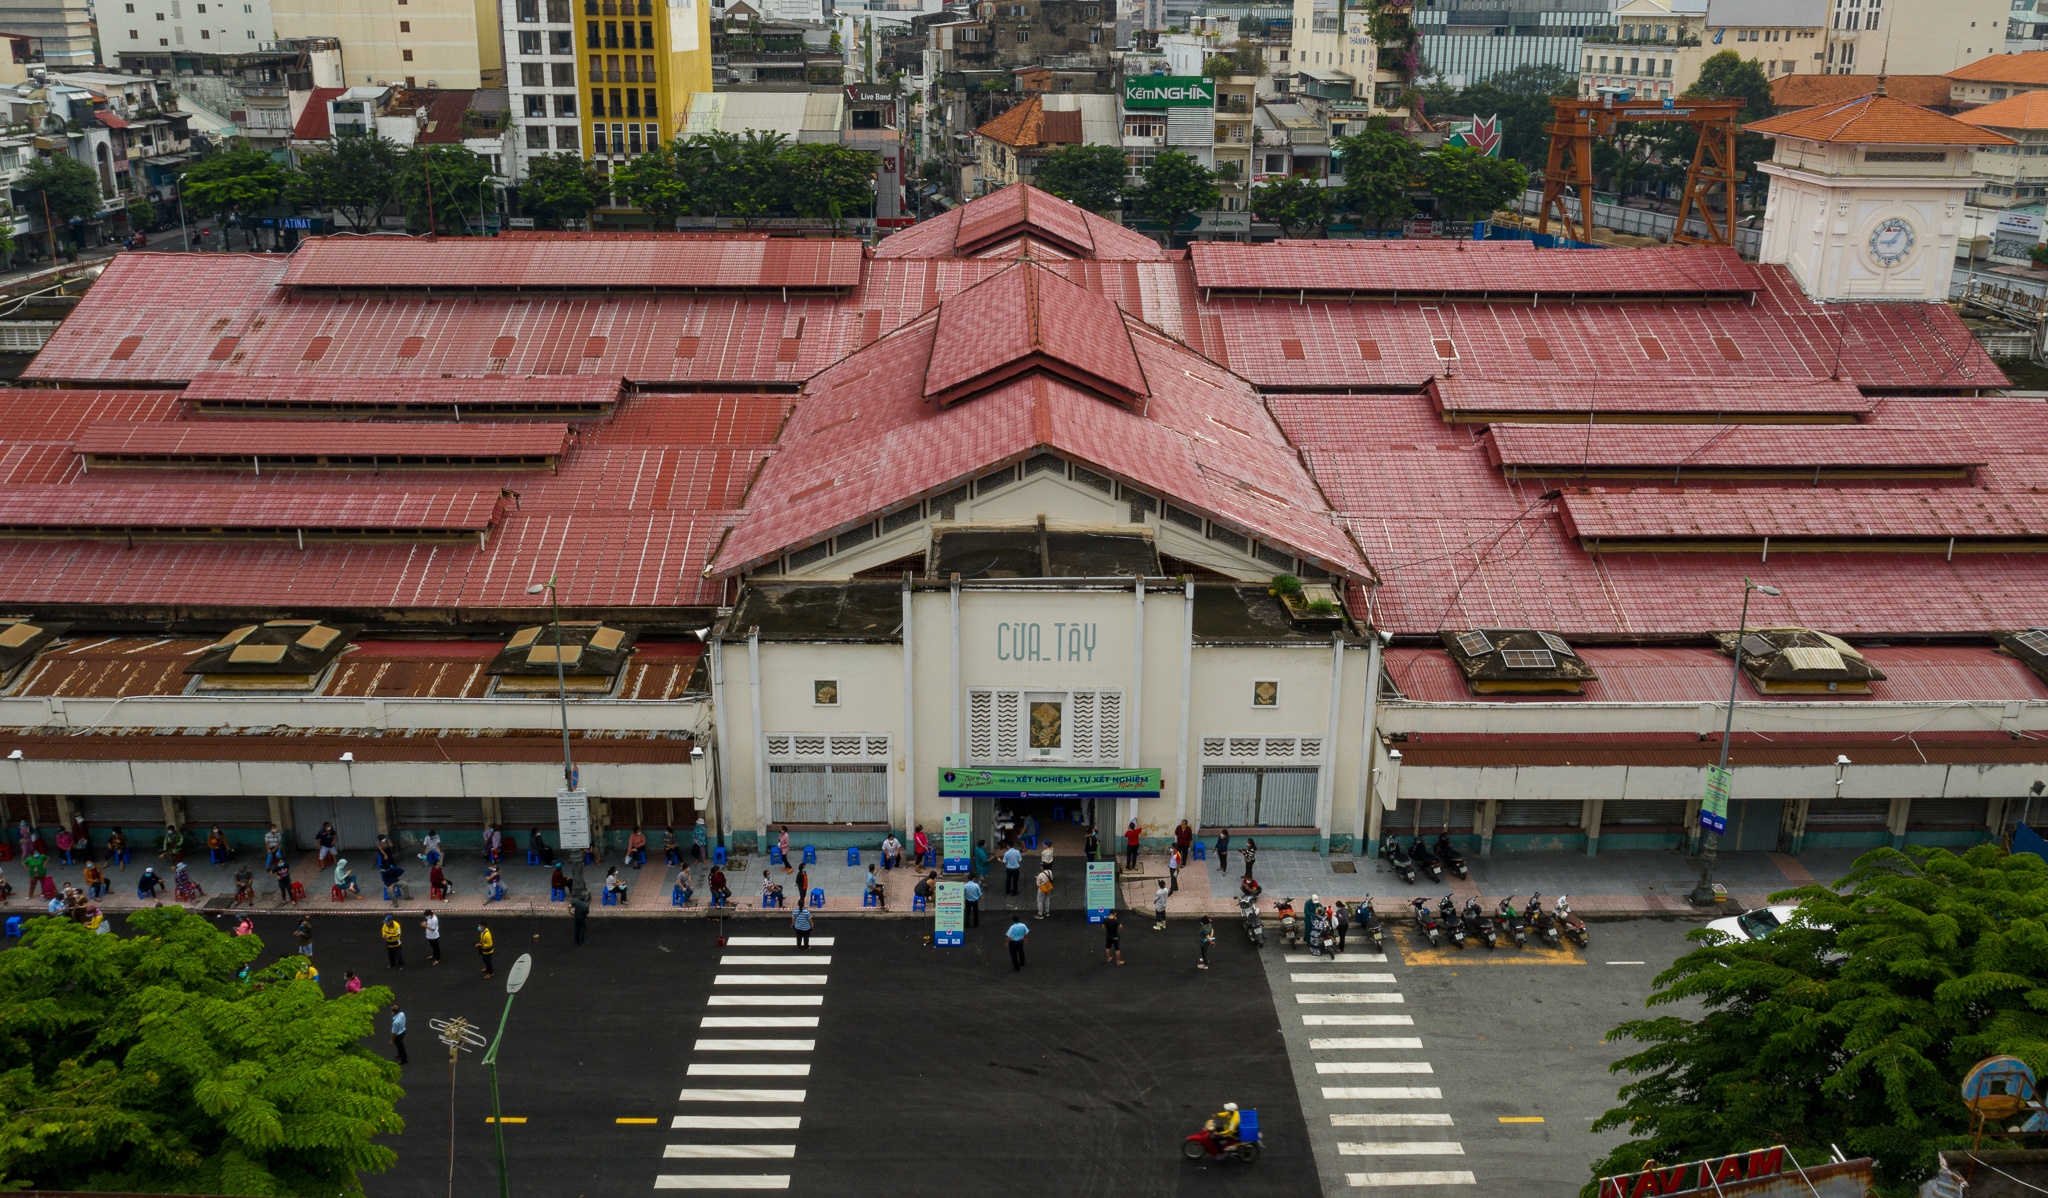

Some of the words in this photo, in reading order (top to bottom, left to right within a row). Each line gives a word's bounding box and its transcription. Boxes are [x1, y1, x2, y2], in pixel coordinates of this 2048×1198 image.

[860, 93, 874, 101] Live
[875, 93, 892, 101] Band
[1016, 775, 1034, 783] XÉT
[1035, 775, 1071, 785] NGHIỆM
[1078, 775, 1092, 785] TỰ
[1093, 775, 1110, 783] XÉT
[1112, 775, 1149, 784] NGHIỆM
